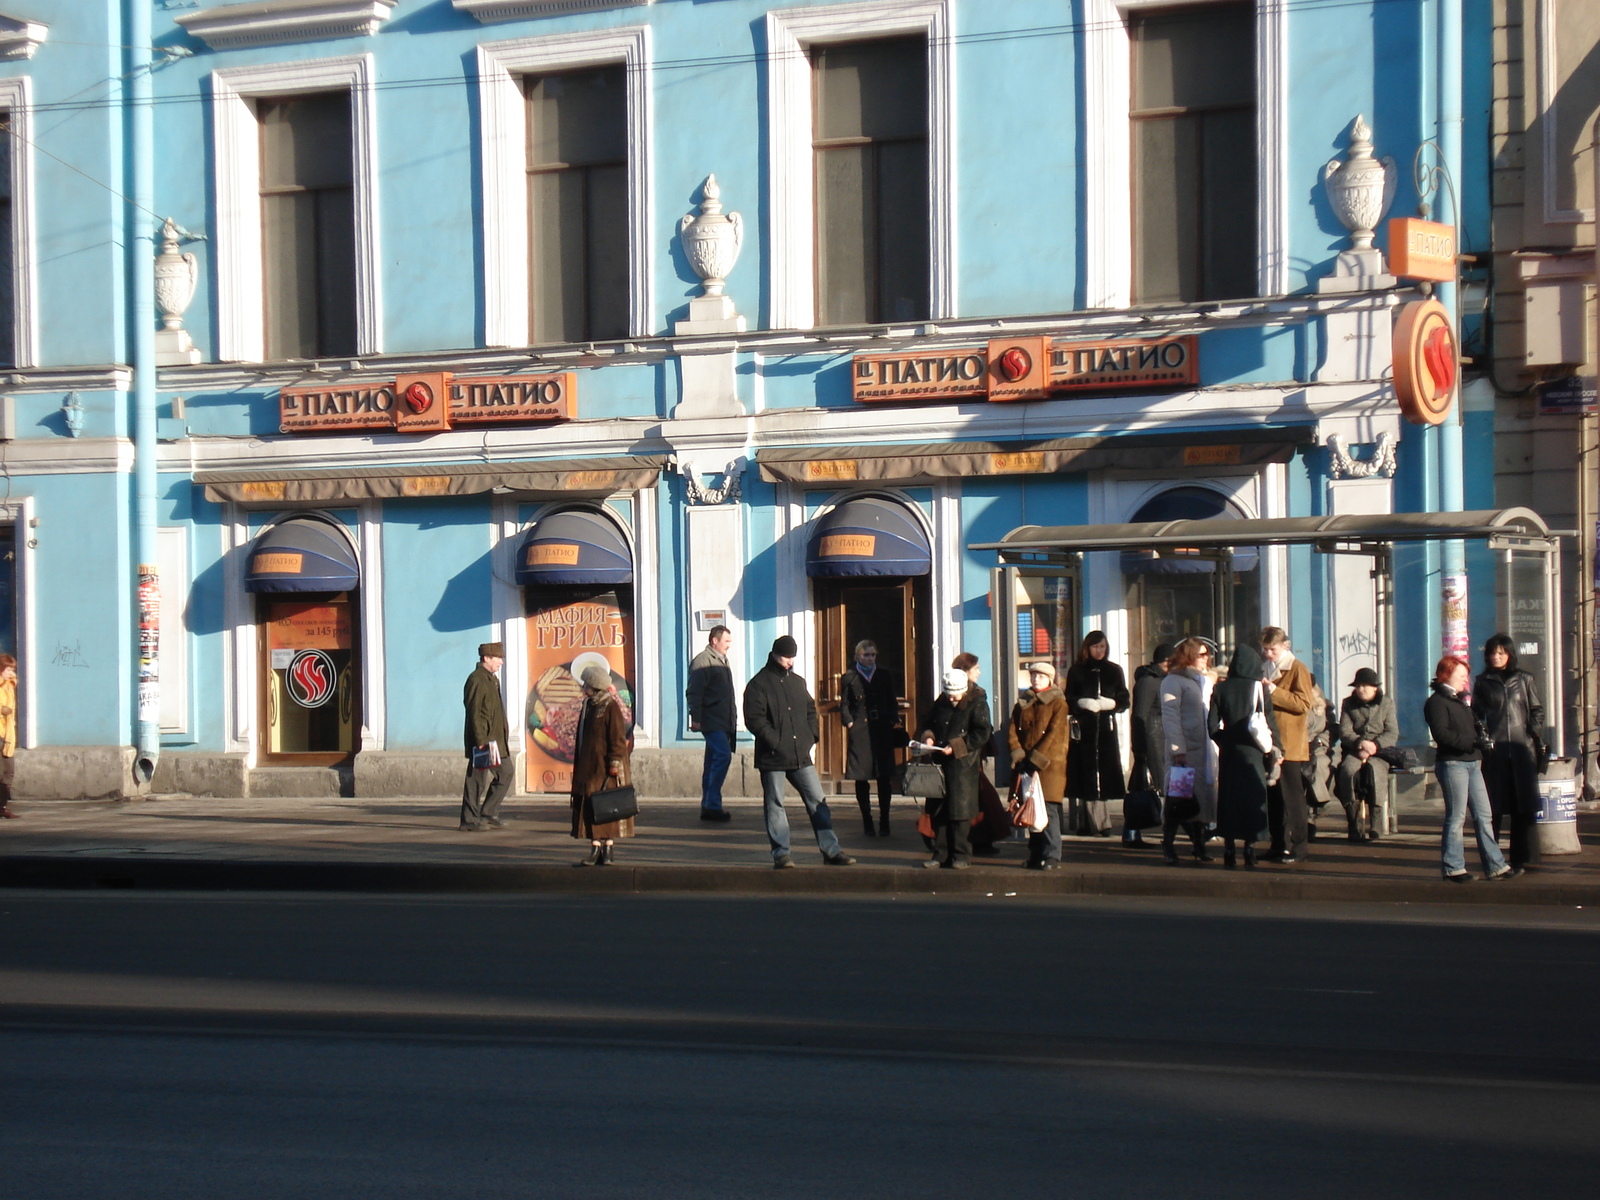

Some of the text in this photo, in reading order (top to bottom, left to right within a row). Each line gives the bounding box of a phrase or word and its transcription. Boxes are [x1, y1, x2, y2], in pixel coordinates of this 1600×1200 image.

[1416, 233, 1453, 258] ПАТИО
[878, 356, 984, 385] ПАТИО
[1073, 342, 1185, 374] ПАТИО
[302, 388, 394, 416] ПАТИО
[468, 380, 561, 407] ПАТИО
[829, 464, 856, 472] ПАТИО
[545, 548, 575, 557] ПАТИО
[840, 539, 871, 548] ПАТИО
[269, 557, 298, 566] ПАТИО
[317, 626, 331, 636] 145
[537, 624, 627, 649] ГРИЛЬ
